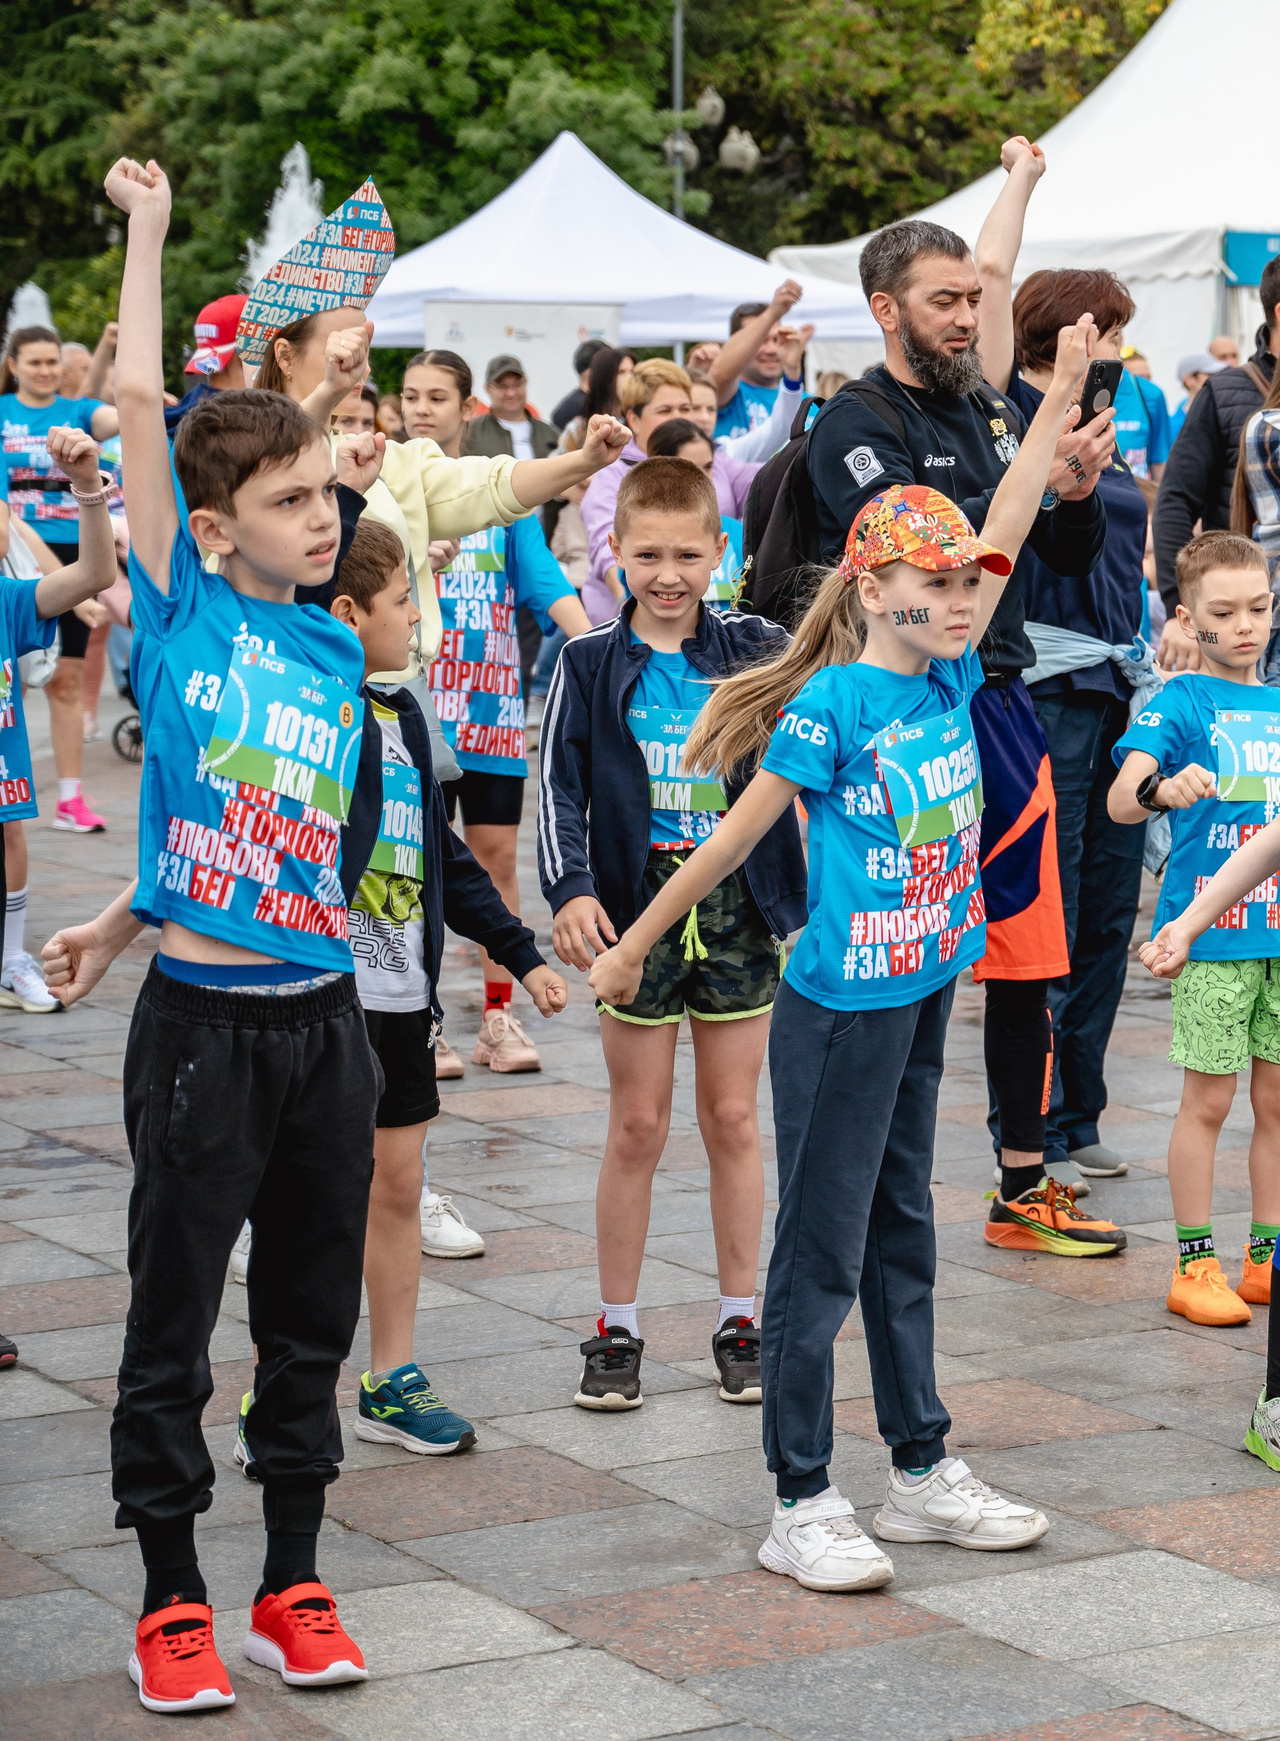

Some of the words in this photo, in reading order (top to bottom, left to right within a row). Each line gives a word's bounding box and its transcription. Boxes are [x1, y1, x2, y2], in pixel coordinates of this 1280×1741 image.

[360, 208, 379, 221] ПСБ
[318, 222, 363, 249] #ЗАБЕГ
[320, 247, 376, 273] #МОМЕНТ
[259, 657, 286, 675] ПСБ
[428, 659, 519, 697] ГОРДОСТЬ
[628, 708, 647, 719] ПСБ
[780, 712, 829, 746] ПСБ
[1233, 714, 1251, 722] ПСБ
[263, 700, 339, 771] 10131
[900, 728, 924, 742] ПСБ
[382, 768, 396, 777] СБ
[918, 738, 977, 802] 10255
[843, 783, 893, 816] #ЗА
[166, 816, 285, 887] #ЛЮБОВЬ
[866, 841, 949, 880] #ЗАБЕГ
[157, 851, 236, 911] #ЗАБЕГ
[843, 939, 925, 980] #ЗАБЕГ
